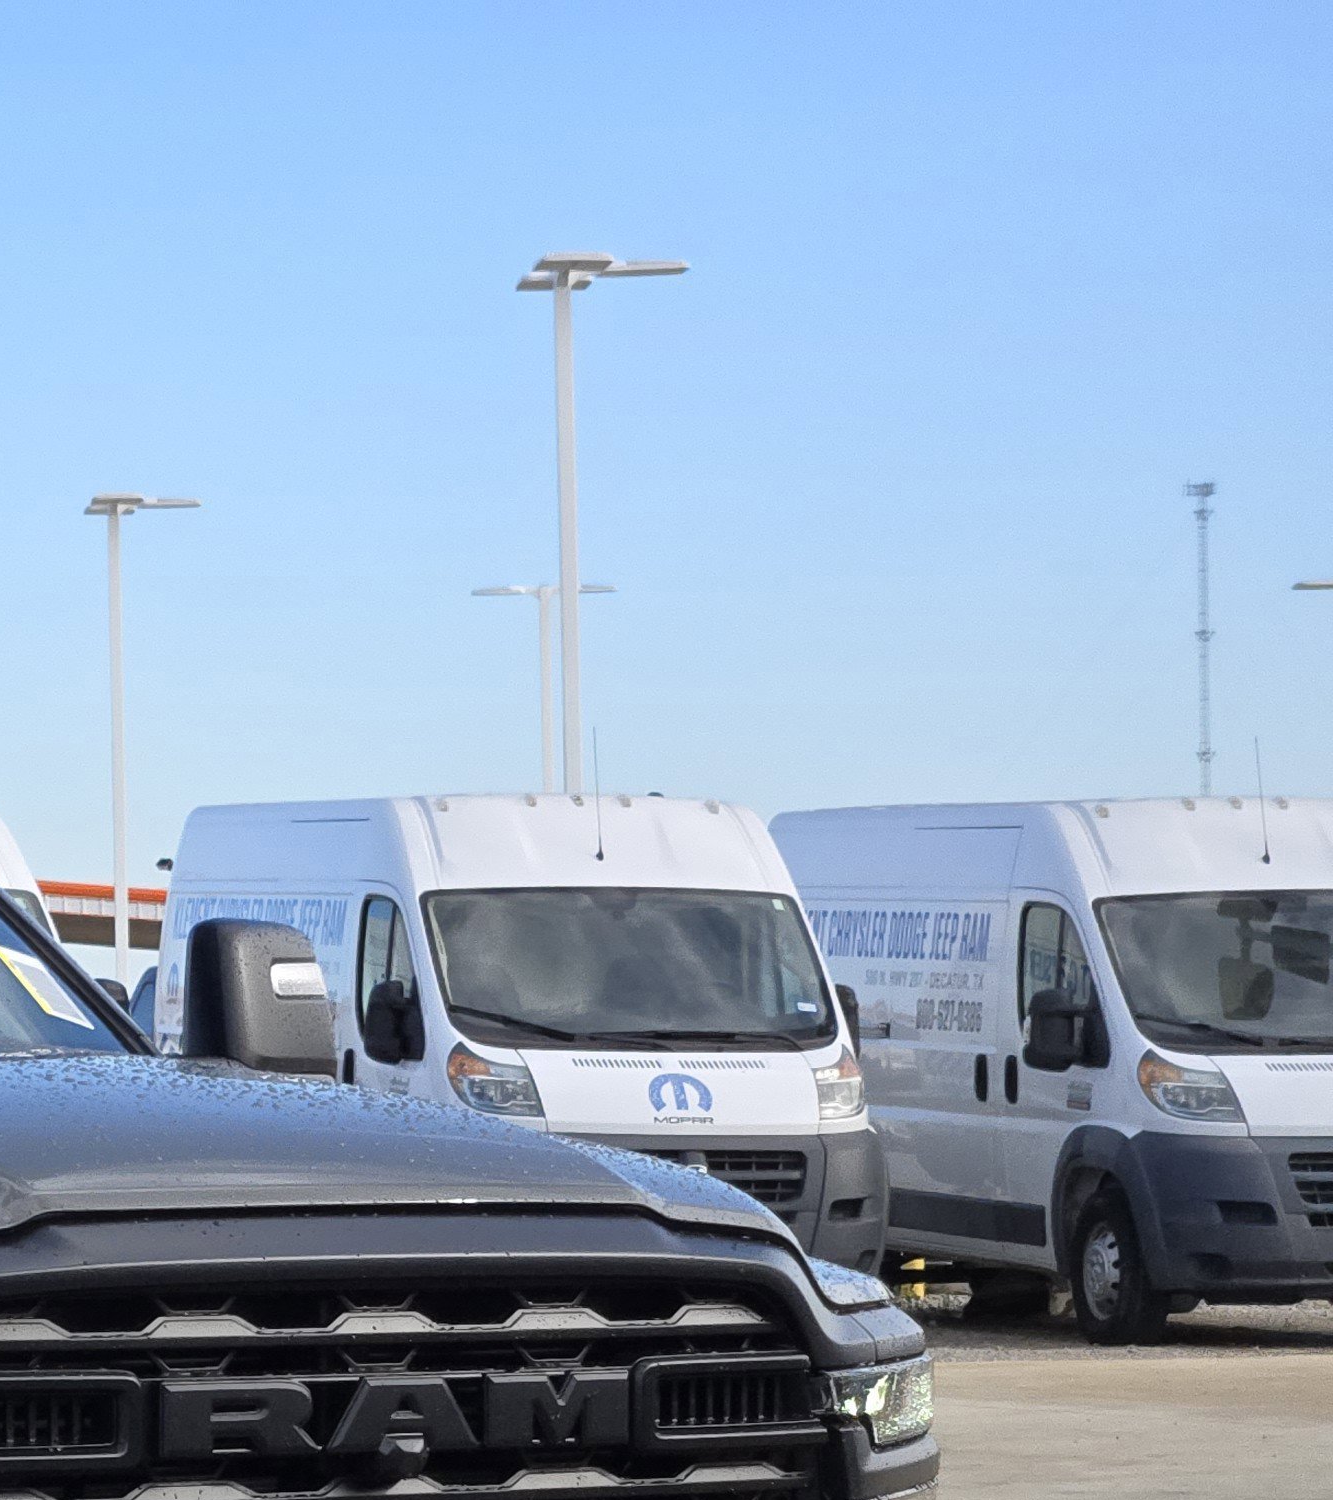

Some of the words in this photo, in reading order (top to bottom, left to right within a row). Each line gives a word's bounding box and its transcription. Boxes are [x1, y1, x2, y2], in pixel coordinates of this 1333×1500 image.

[828, 909, 887, 958] CHRYSLER
[887, 911, 930, 960] DODGE
[929, 911, 960, 961] JEEP
[959, 912, 991, 962] RAM
[653, 1116, 714, 1124] MOPAR
[159, 1369, 628, 1457] RAM
